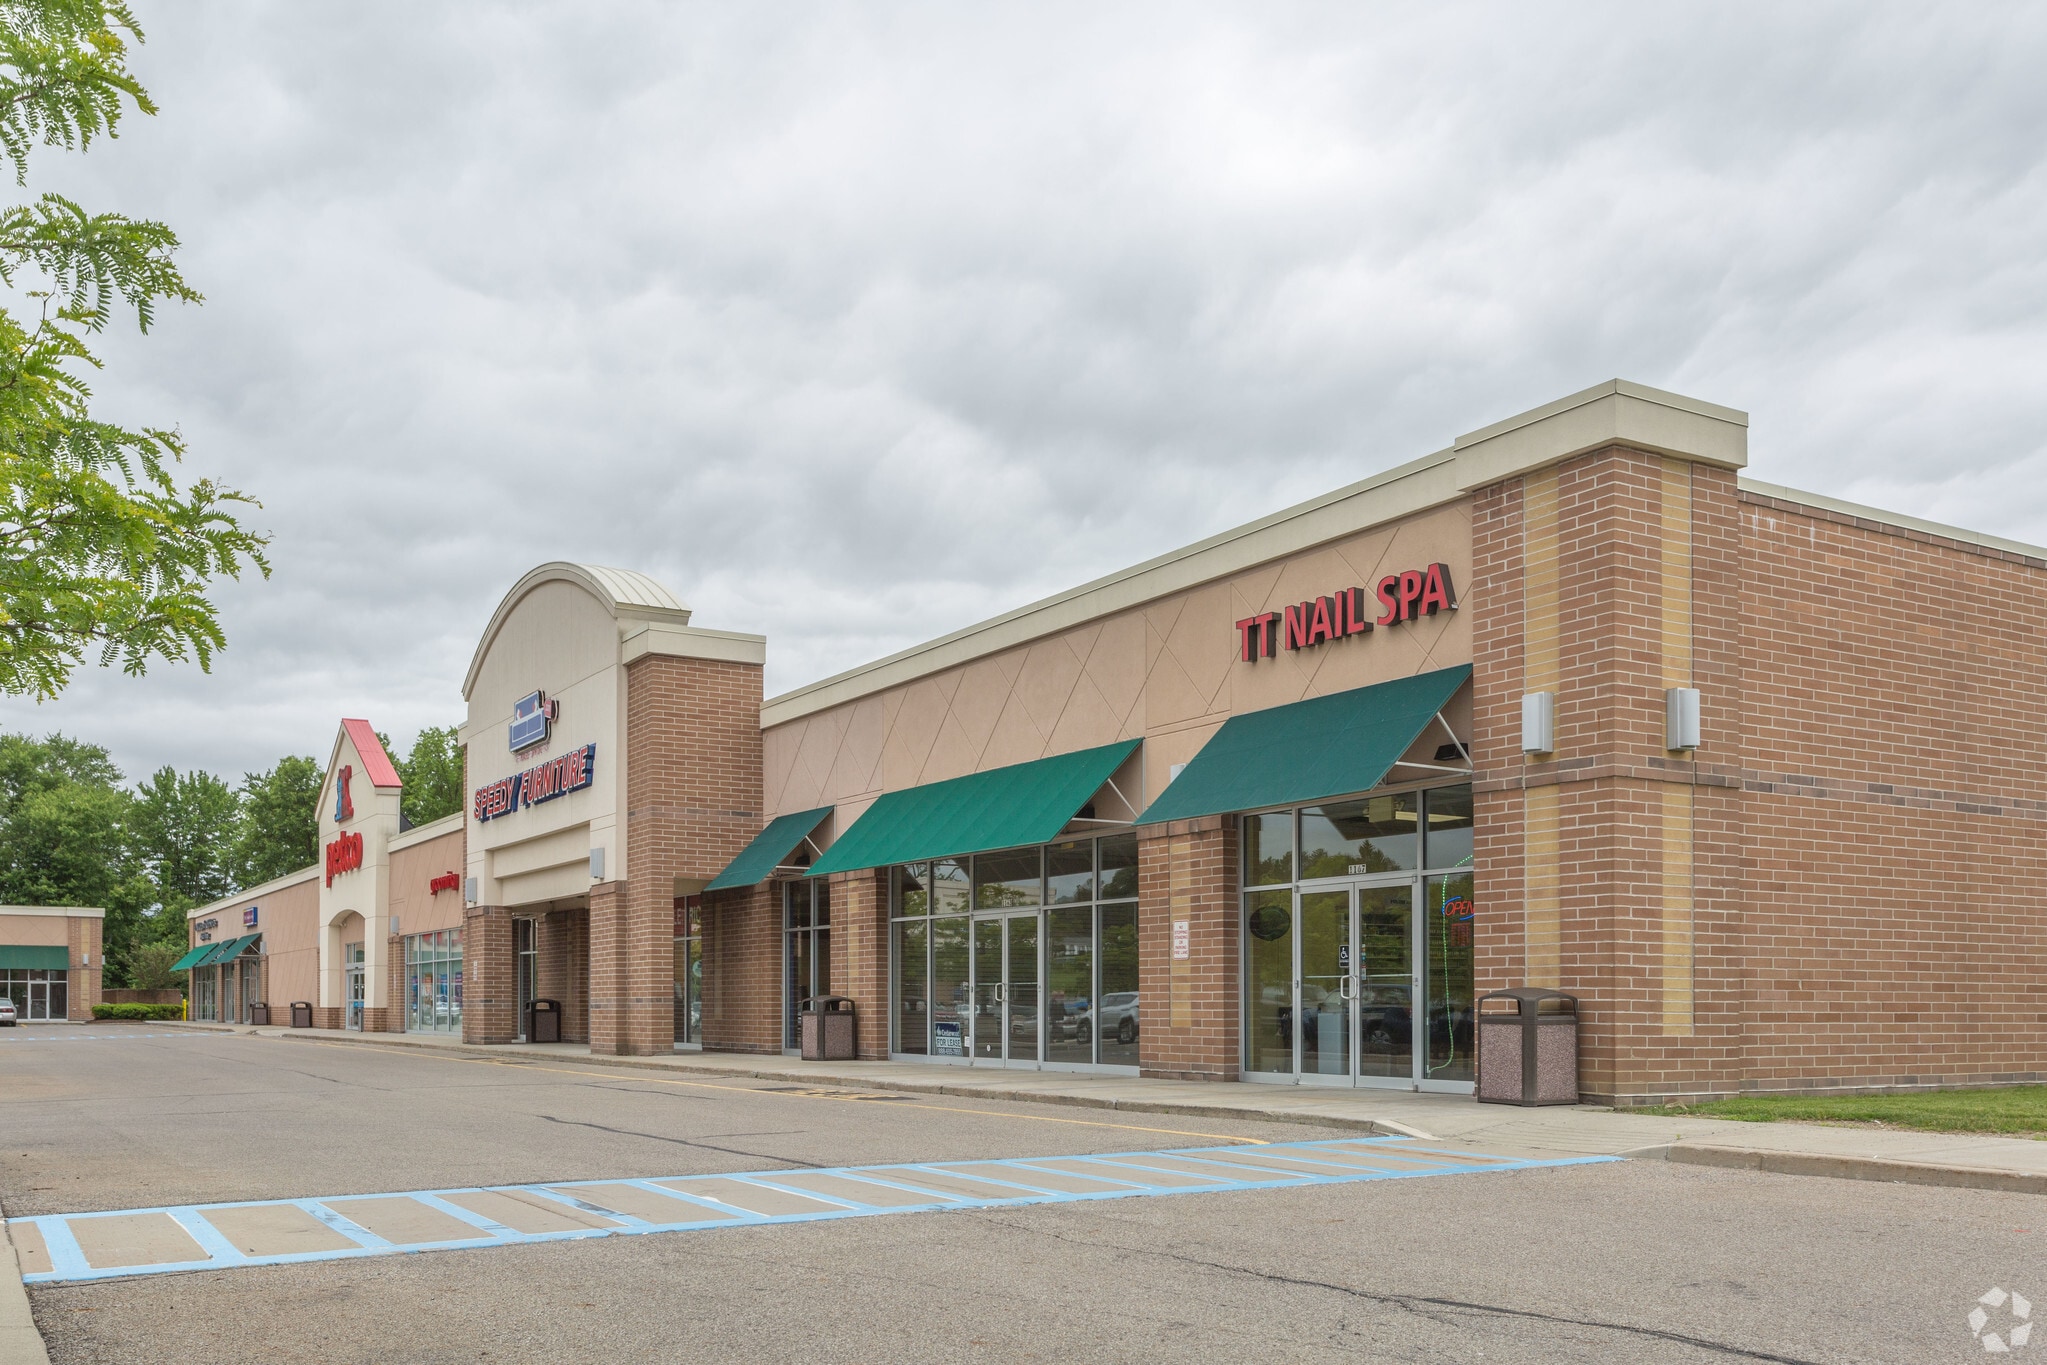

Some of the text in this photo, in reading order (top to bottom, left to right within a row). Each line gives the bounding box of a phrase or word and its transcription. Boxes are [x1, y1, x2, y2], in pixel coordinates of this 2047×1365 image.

[1236, 562, 1458, 663] TT NAIL SPA
[473, 743, 594, 823] SPEEDY FURNITURE
[1445, 900, 1475, 916] OPEN
[936, 1038, 961, 1048] FOR LEASE
